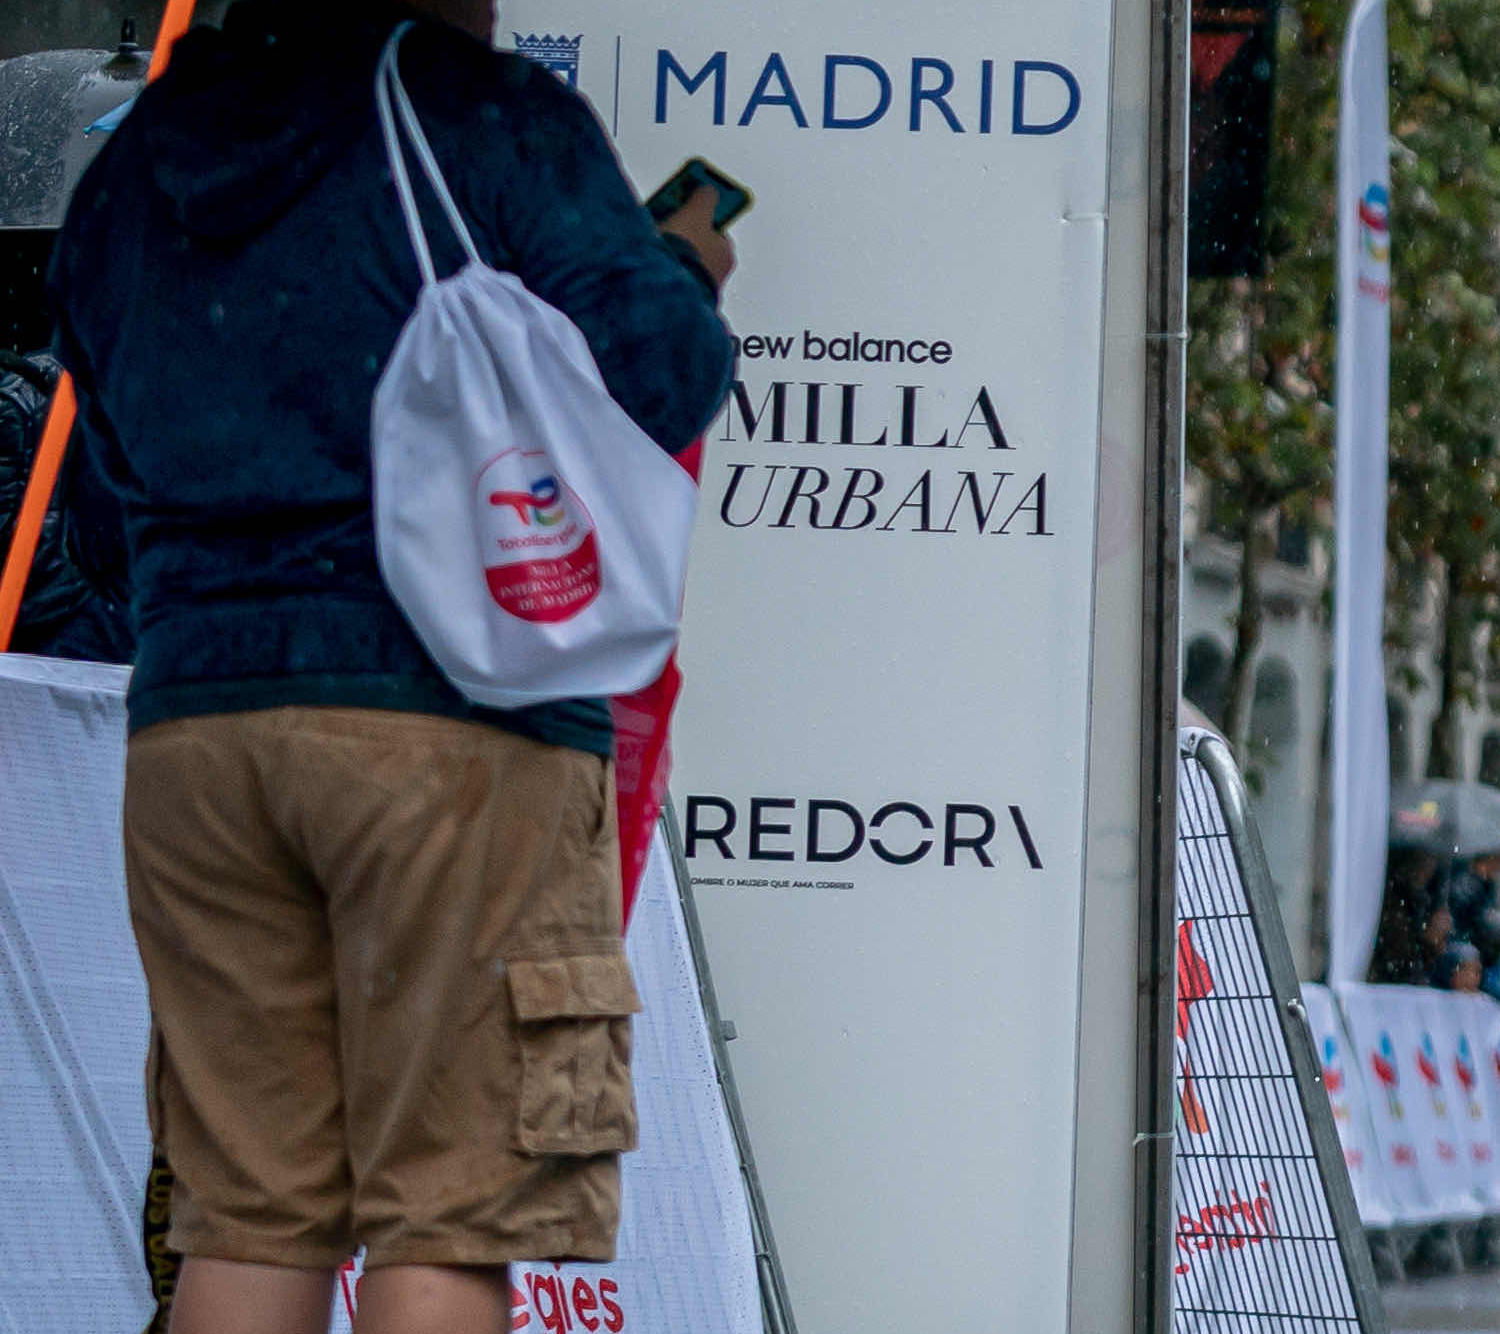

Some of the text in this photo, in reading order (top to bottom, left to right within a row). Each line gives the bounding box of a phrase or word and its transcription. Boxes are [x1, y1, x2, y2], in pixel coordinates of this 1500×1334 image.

[655, 49, 1081, 137] MADRID
[803, 330, 953, 364] balance
[720, 378, 1016, 451] MILLA
[719, 463, 1055, 537] URBANA
[691, 877, 724, 886] OMBRE
[792, 880, 814, 889] AMA
